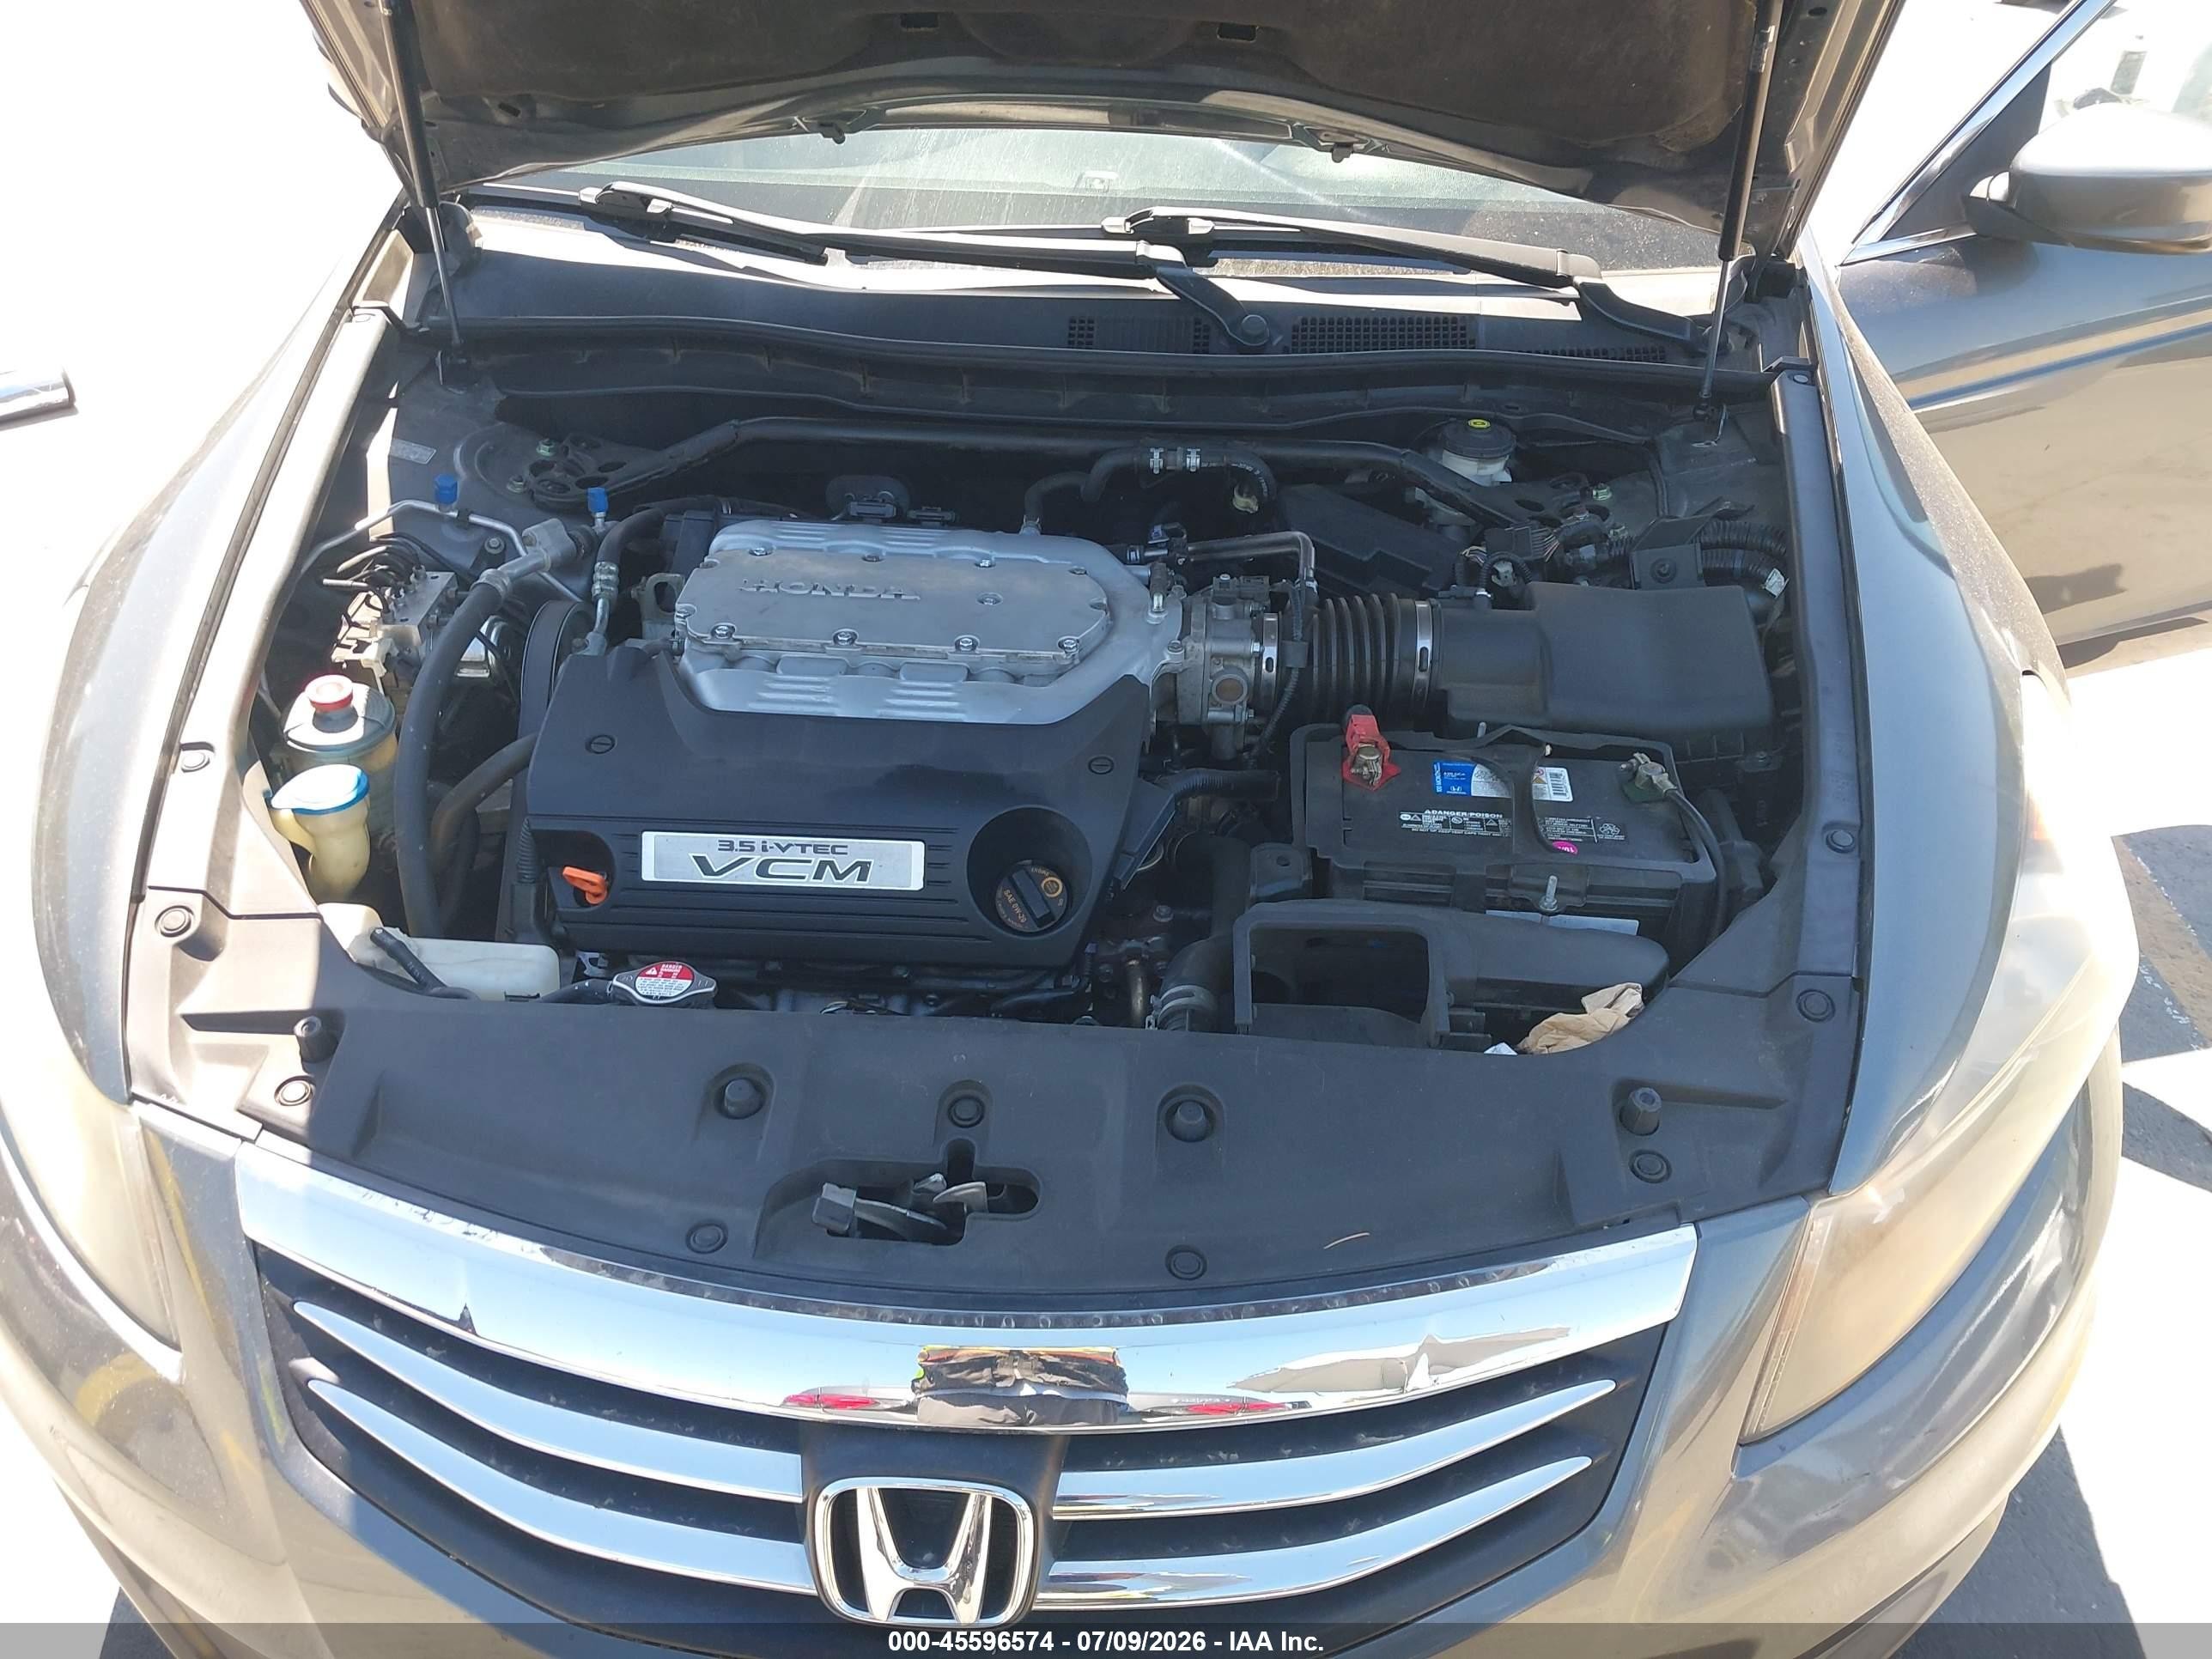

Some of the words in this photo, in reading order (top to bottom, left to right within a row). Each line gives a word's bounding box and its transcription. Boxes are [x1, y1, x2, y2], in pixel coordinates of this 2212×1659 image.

[739, 579, 921, 600] HONDA
[718, 839, 756, 853] 3.5
[690, 854, 873, 884] VCM
[1003, 889, 1015, 904] SAE
